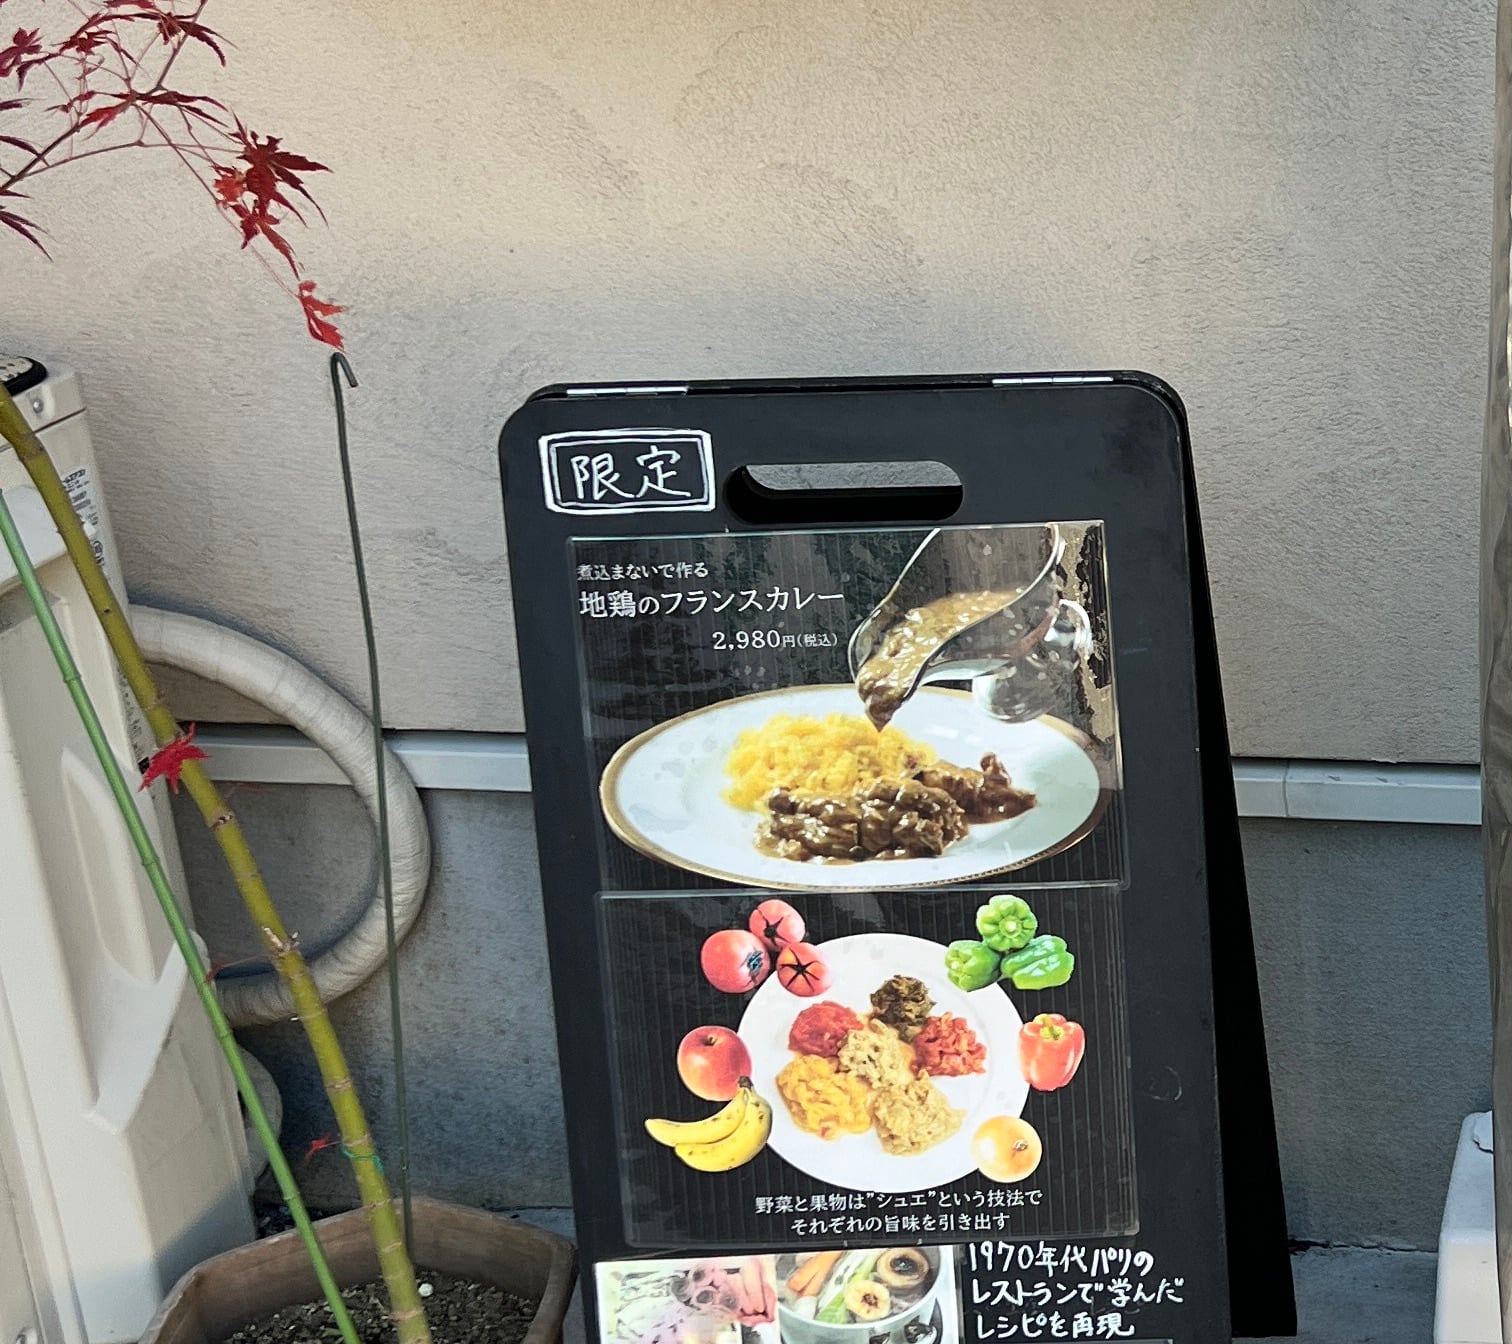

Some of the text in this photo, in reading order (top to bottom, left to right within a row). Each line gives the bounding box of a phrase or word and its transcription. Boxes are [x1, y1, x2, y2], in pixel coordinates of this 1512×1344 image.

[570, 444, 692, 502] 限定
[575, 562, 709, 581] 煮込まないで作る
[578, 585, 845, 619] 地鶏のフランスカレー
[790, 1212, 1011, 1236] それぞれの旨味を引き出す
[968, 1240, 1155, 1278] 1970年代パリの
[971, 1276, 1185, 1308] レストランで学んだ
[976, 1310, 1136, 1340] レシピを再現
